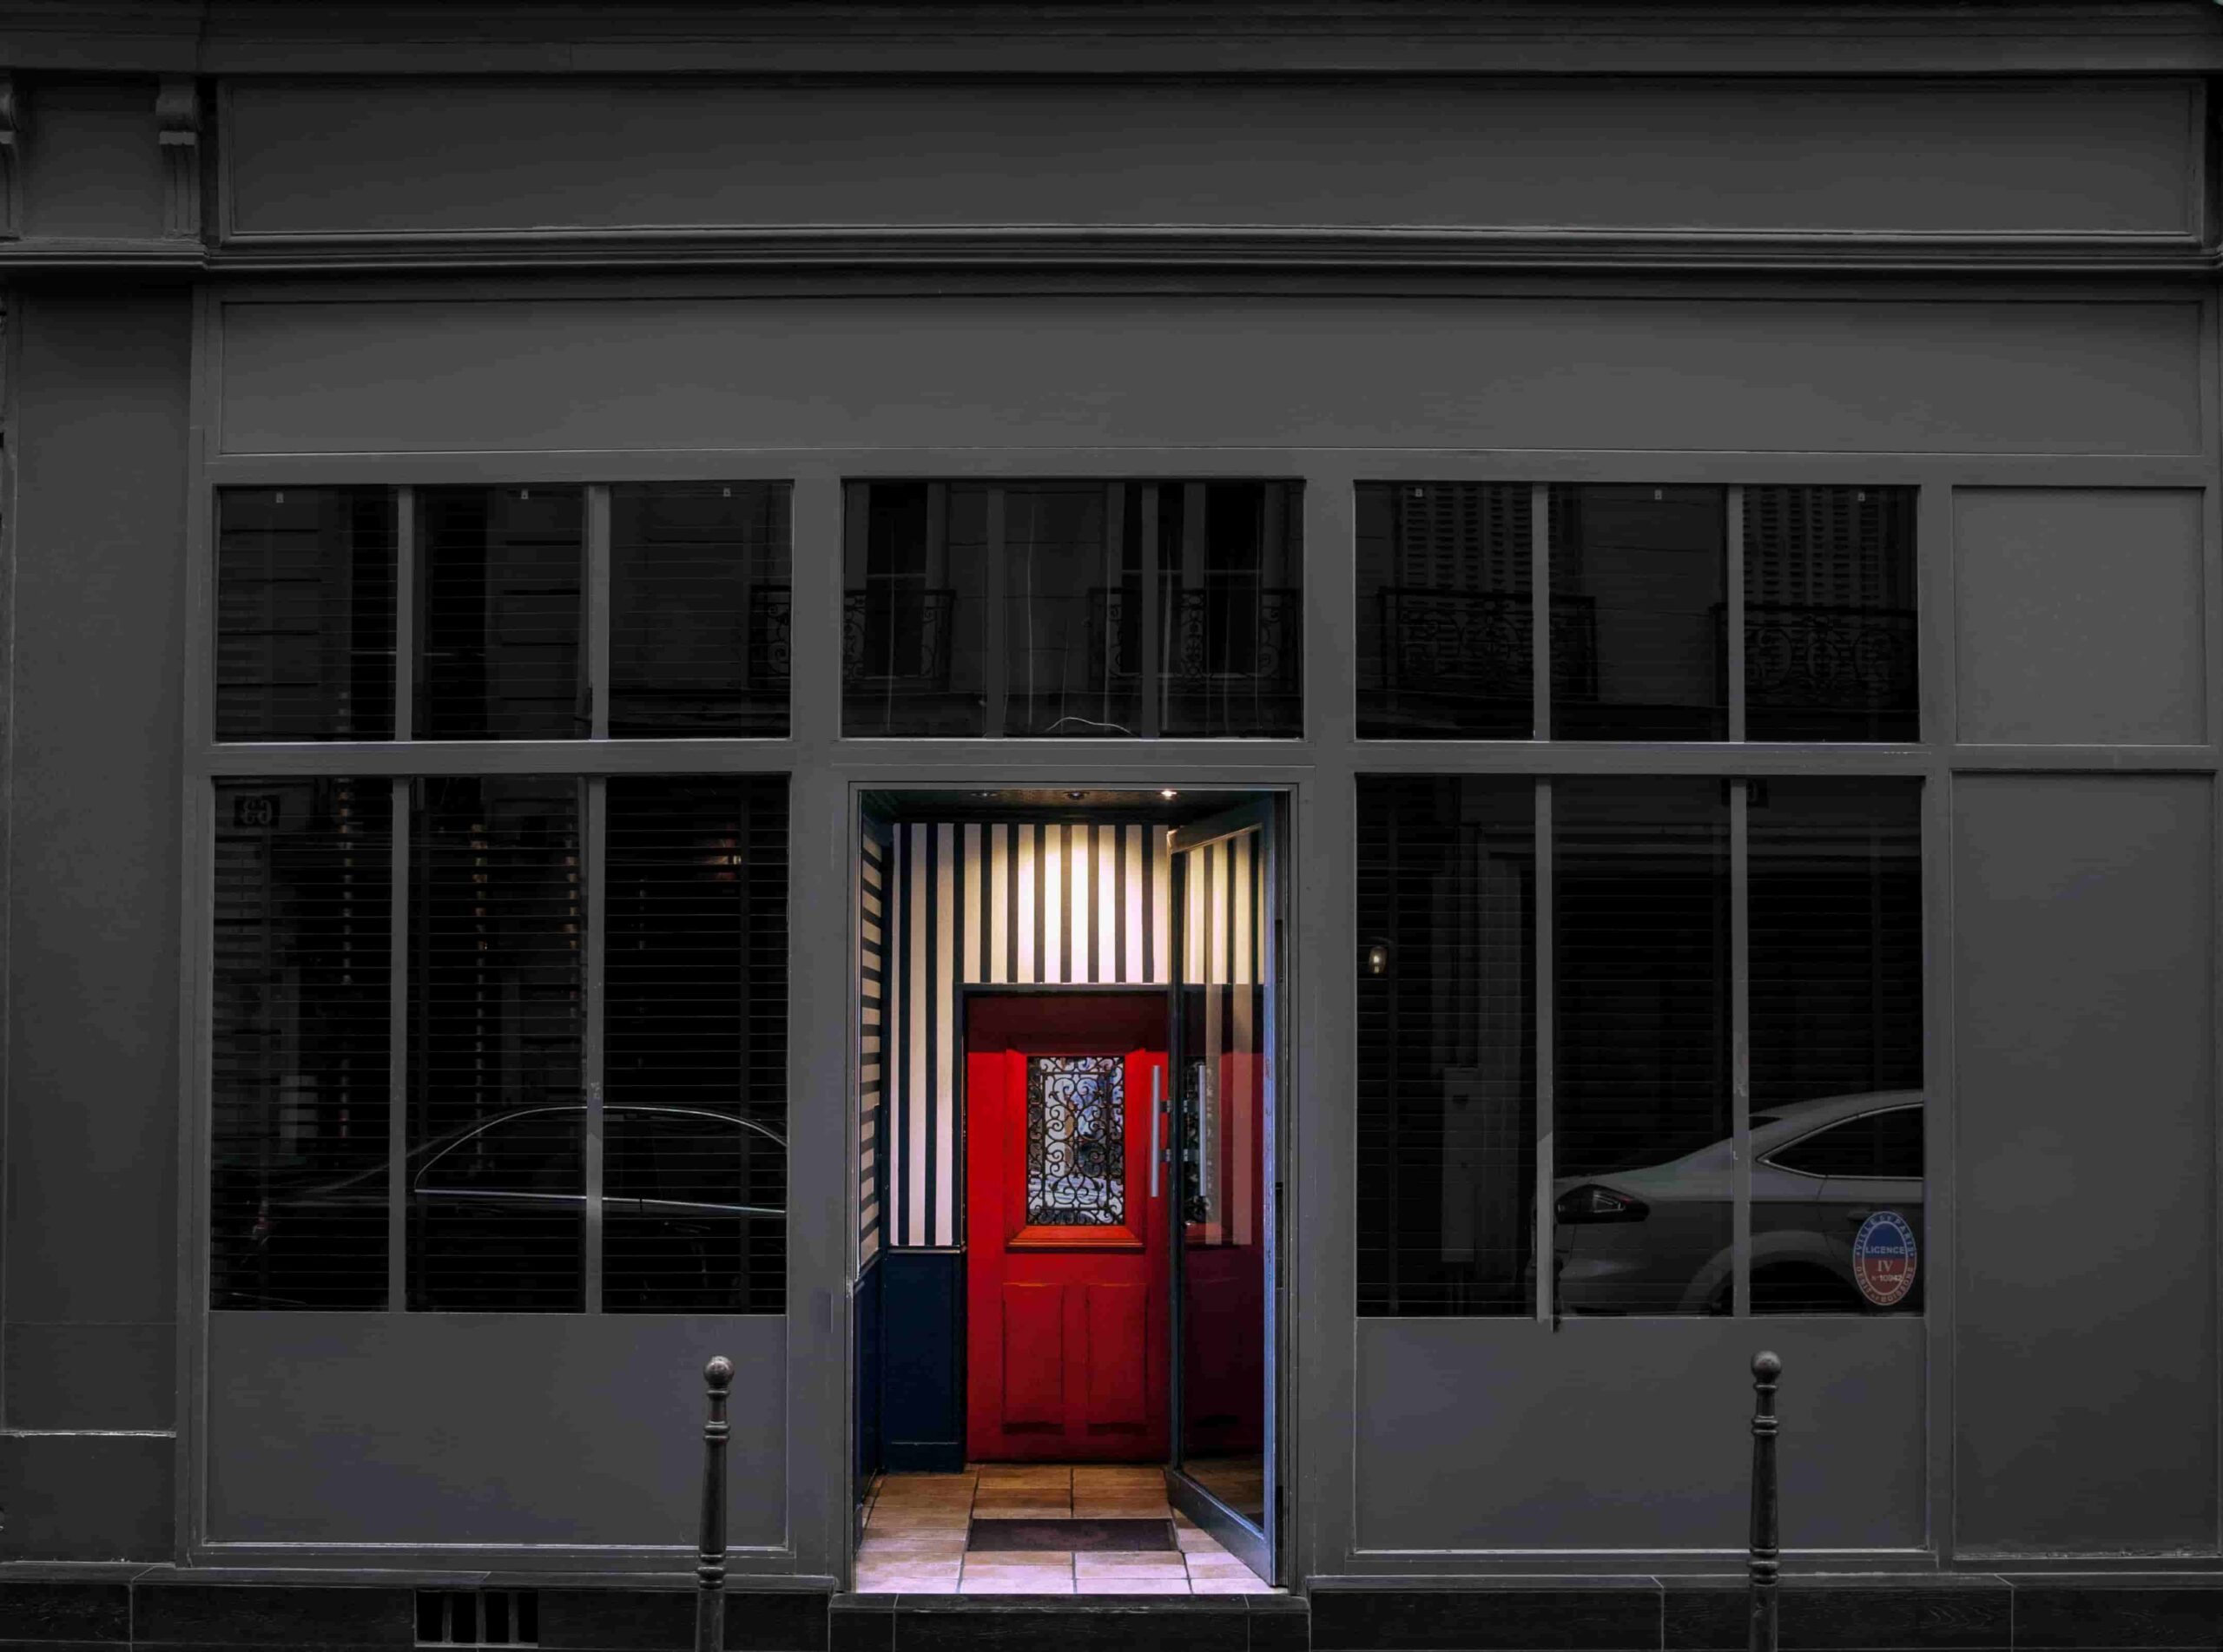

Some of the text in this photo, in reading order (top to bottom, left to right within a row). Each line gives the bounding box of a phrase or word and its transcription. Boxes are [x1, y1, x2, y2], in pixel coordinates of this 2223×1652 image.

[1856, 1217, 1877, 1251] VILLE
[1894, 1218, 1914, 1254] PARIS
[1865, 1246, 1906, 1254] LICENCE
[1877, 1260, 1893, 1272] IV
